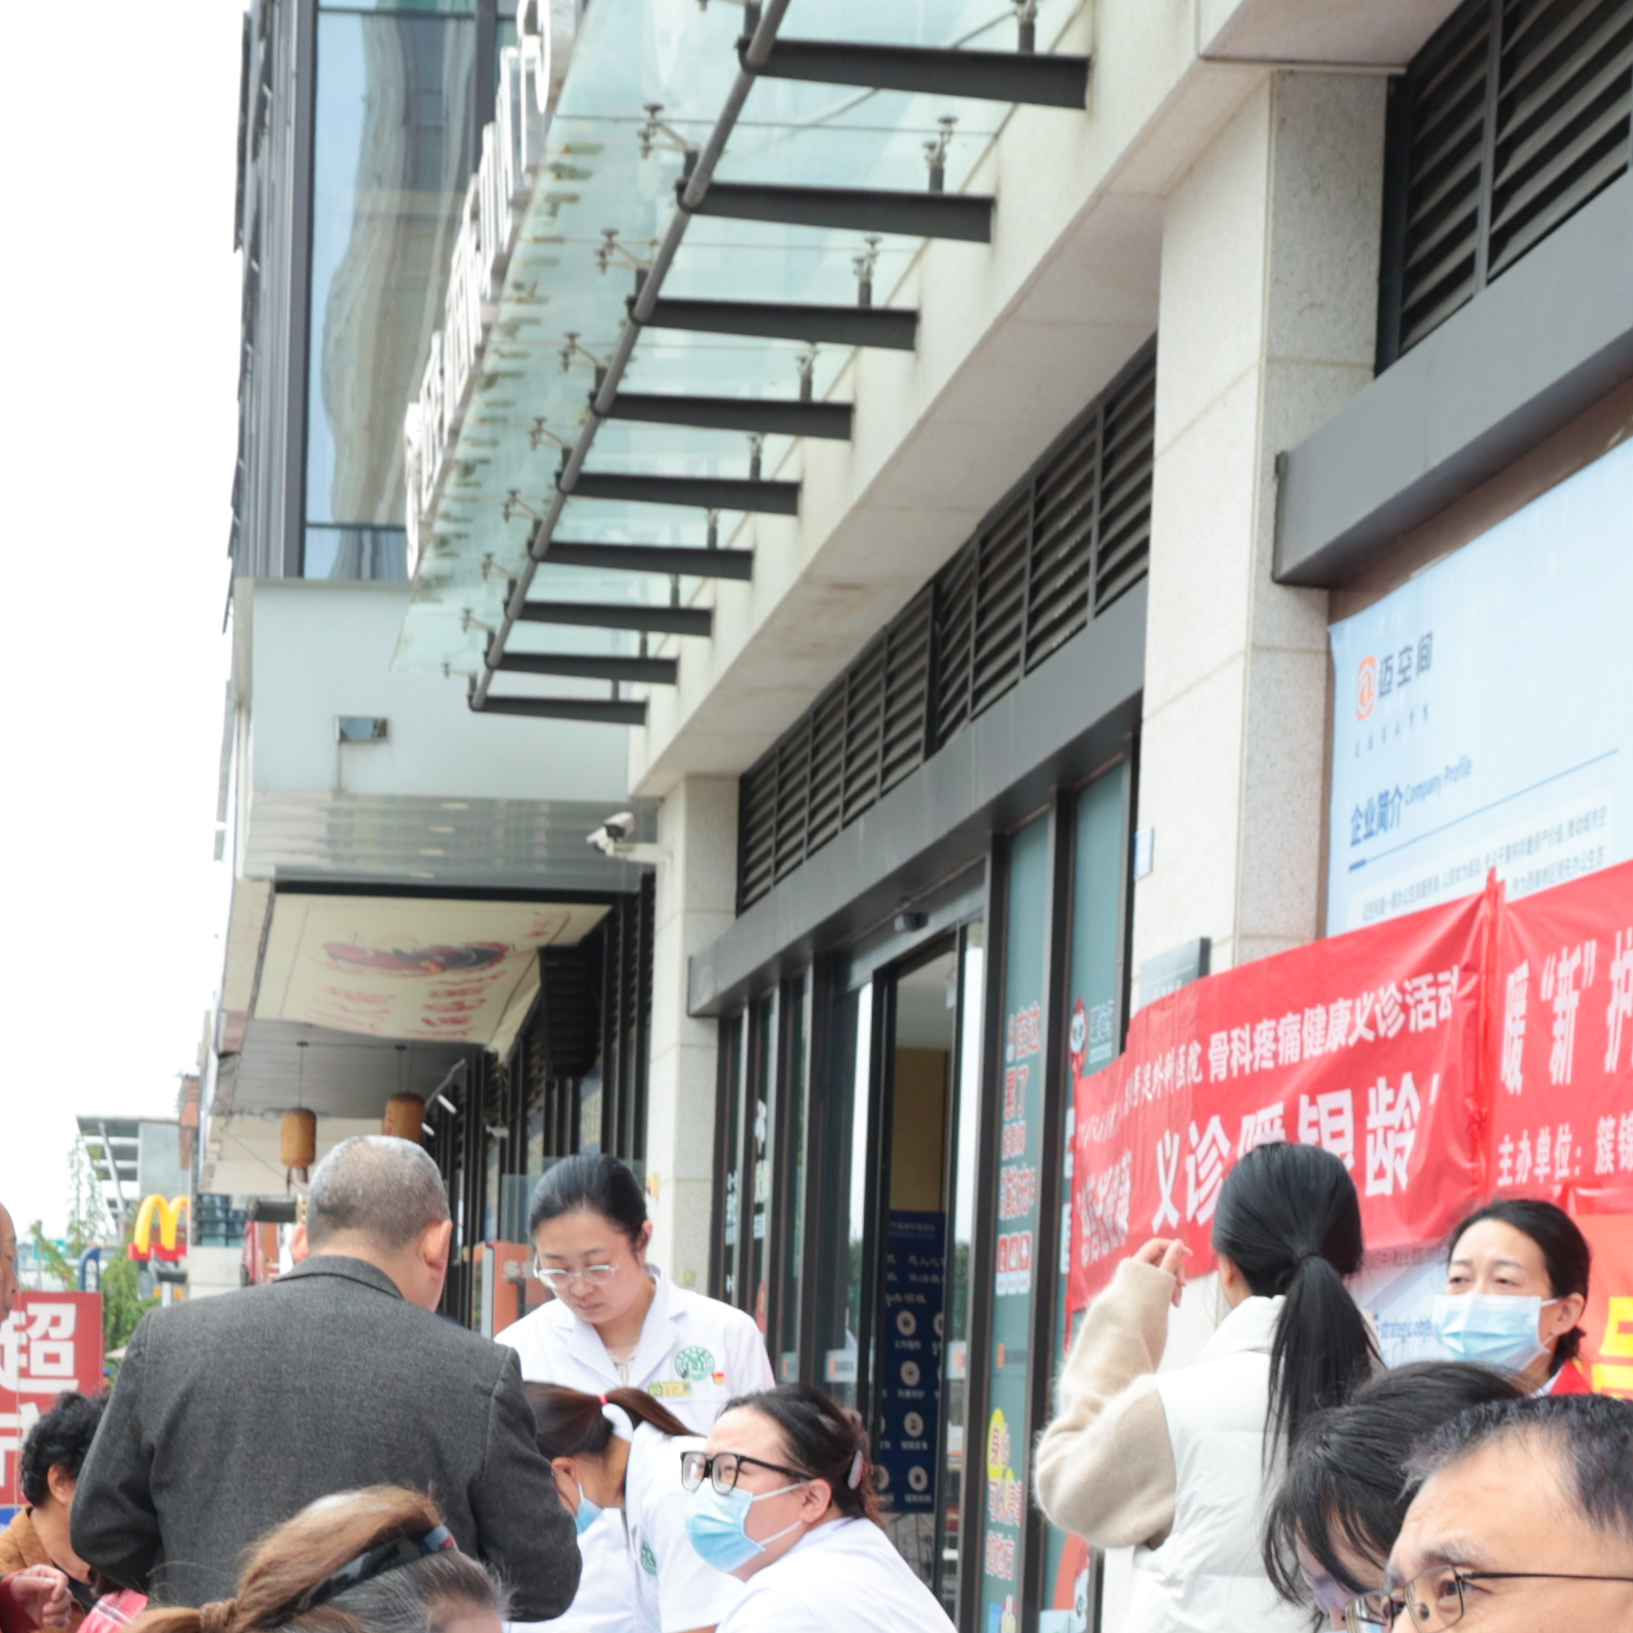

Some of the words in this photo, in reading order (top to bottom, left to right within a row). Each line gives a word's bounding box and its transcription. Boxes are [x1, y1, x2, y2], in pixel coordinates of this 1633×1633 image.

[1378, 631, 1433, 698] 迈空间
[1350, 783, 1403, 848] 企业简介
